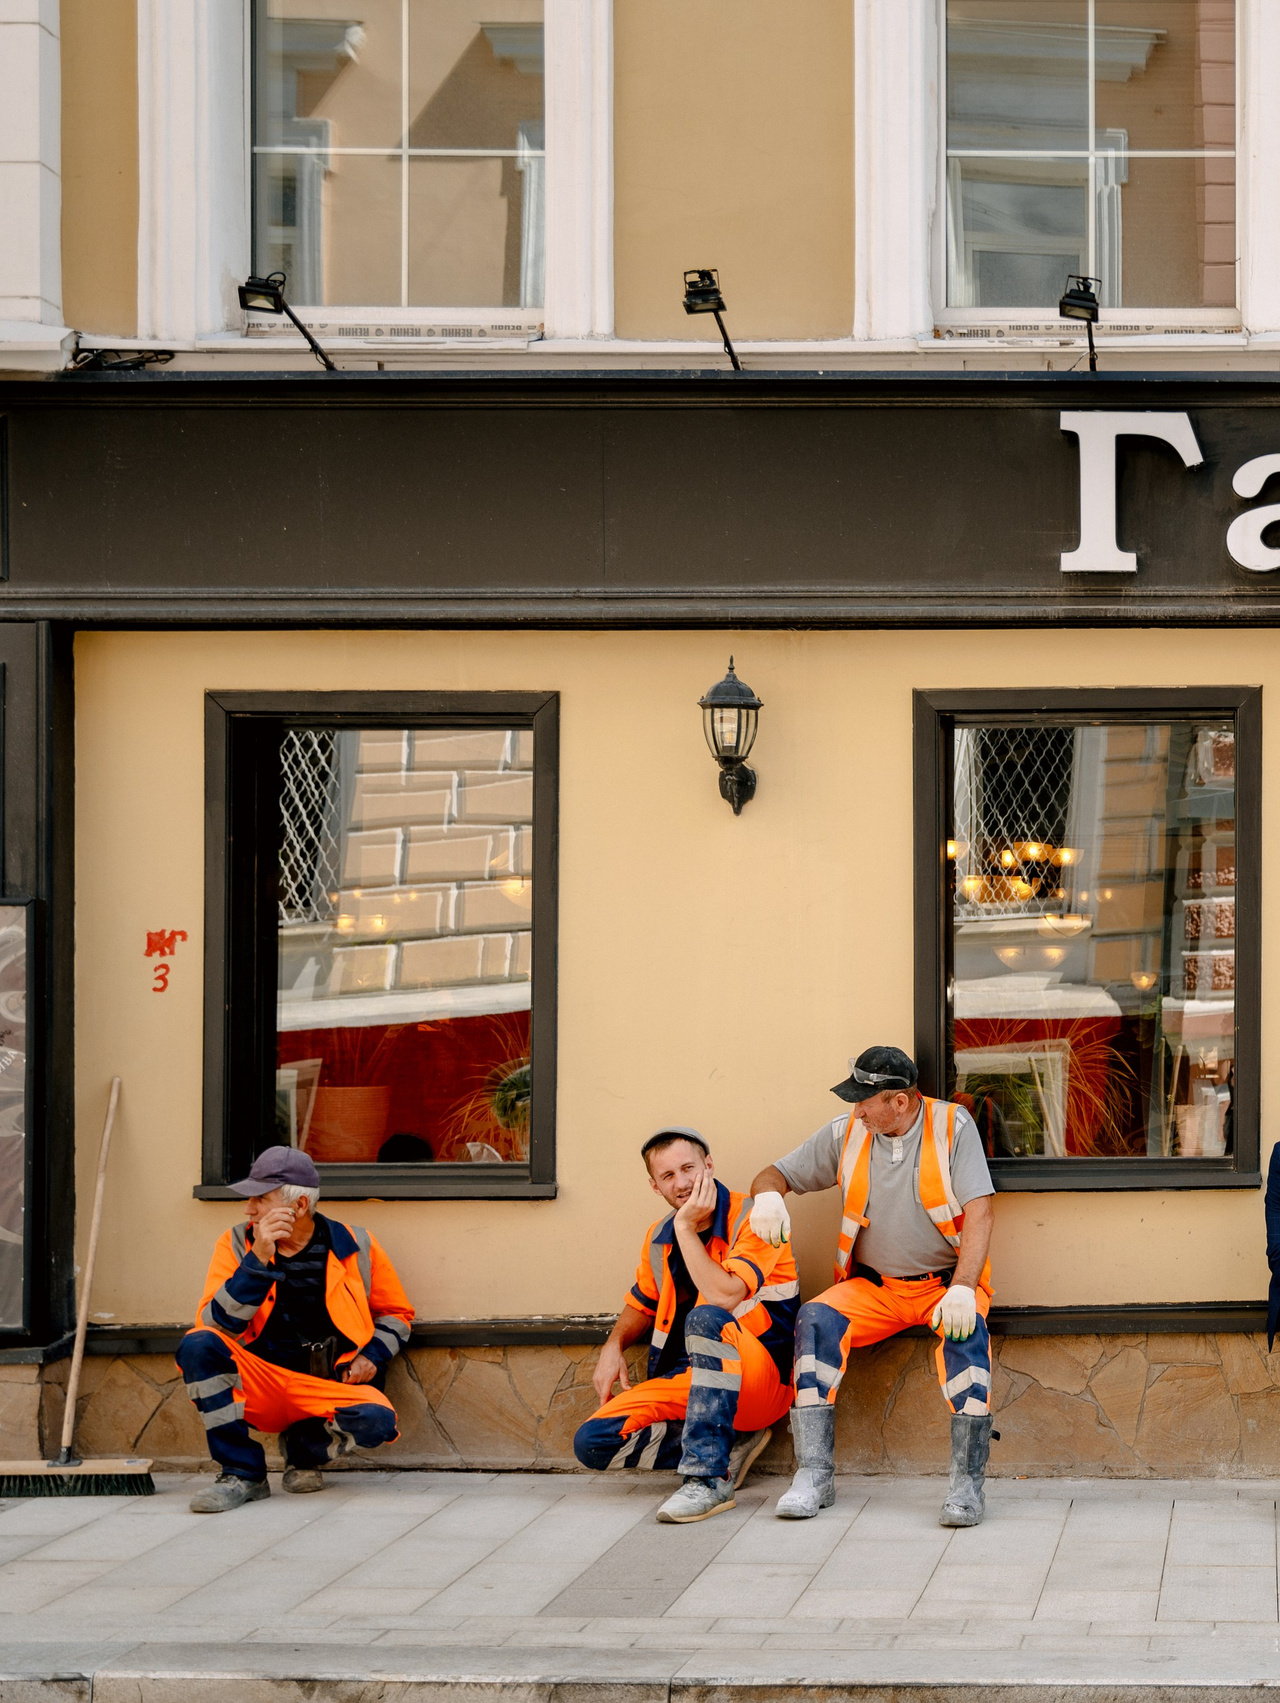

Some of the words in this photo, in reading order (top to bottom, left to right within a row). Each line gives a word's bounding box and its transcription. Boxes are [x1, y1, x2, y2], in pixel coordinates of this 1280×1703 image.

[338, 328, 370, 337] REHAU
[390, 328, 421, 337] REHAU
[441, 328, 473, 338] REHAU
